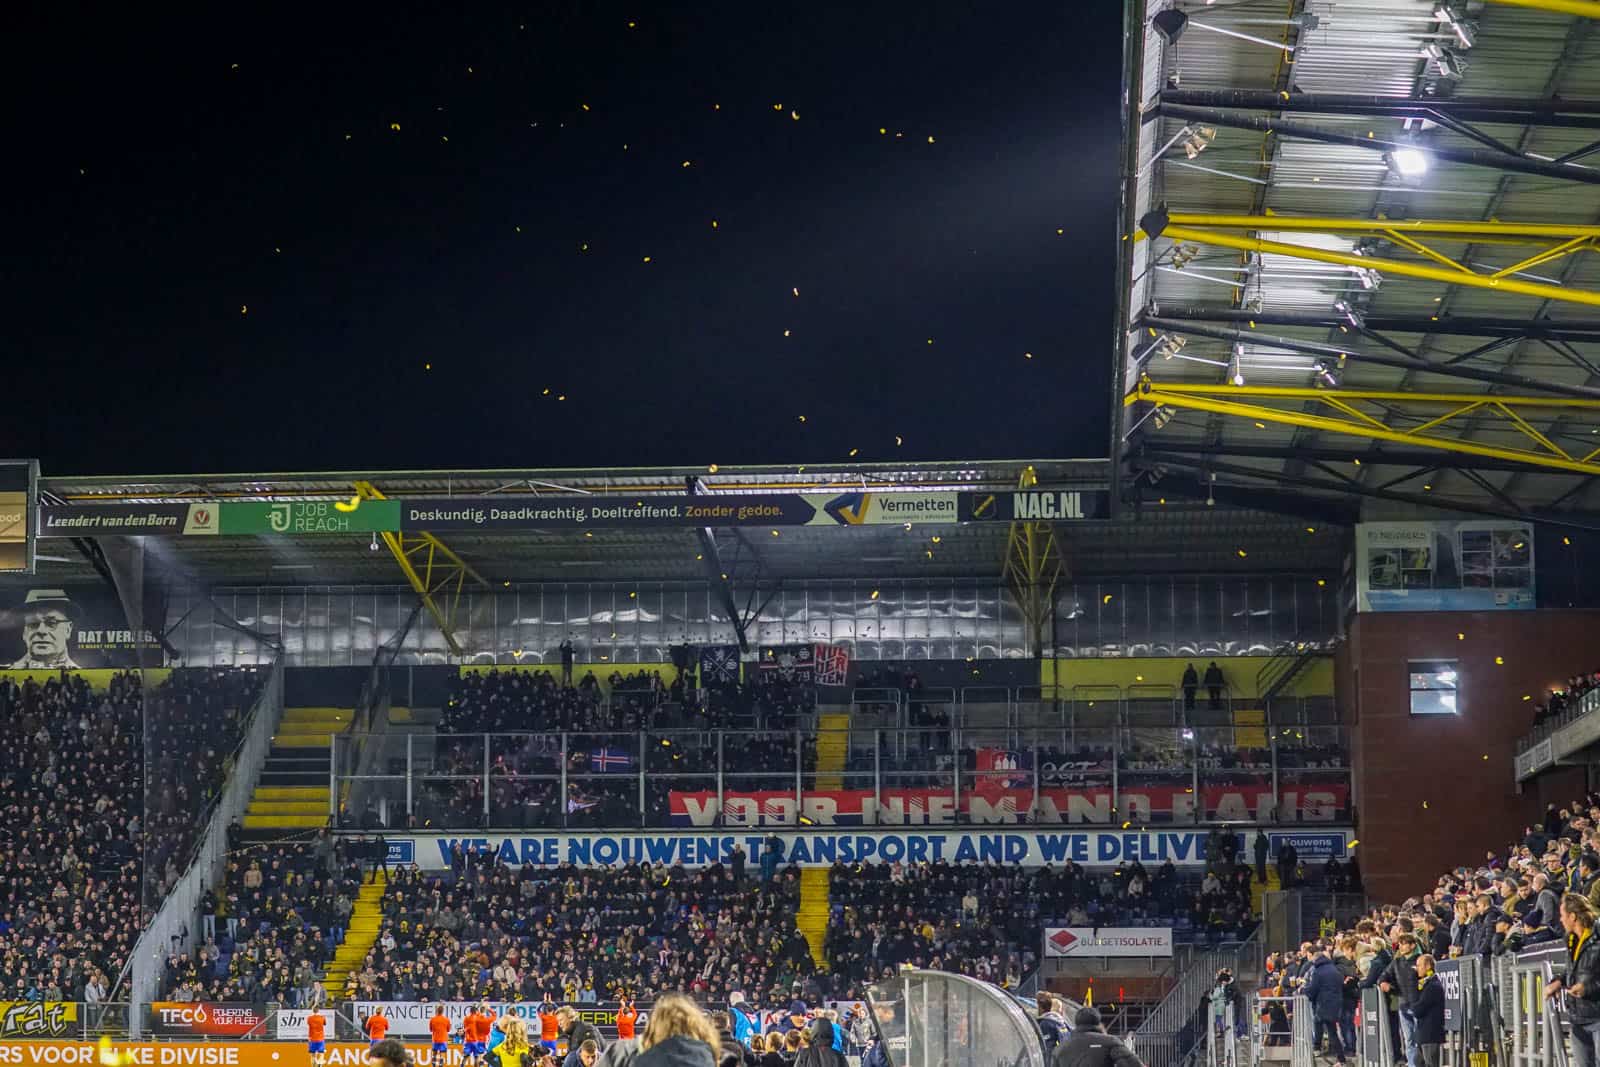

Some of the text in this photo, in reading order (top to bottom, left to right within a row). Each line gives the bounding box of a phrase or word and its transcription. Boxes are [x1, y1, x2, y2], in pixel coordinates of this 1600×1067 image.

[295, 503, 328, 516] JOB
[879, 498, 954, 511] Vermetten
[1013, 493, 1084, 518] NAC.NL
[47, 514, 177, 527] Leendert van den Born
[410, 505, 784, 523] Deskundig. Daadkrachtig. Doeltreffend. Zonder gedoe.
[295, 517, 349, 531] REACH
[78, 631, 103, 643] RAT
[682, 796, 838, 826] VOOR
[862, 793, 1151, 825] NIEMAND
[497, 838, 559, 865] ARE
[568, 837, 736, 865] NOUWENS
[954, 835, 1028, 863] AND
[1036, 834, 1088, 862] WE
[1097, 833, 1246, 862] DELIVE
[235, 1016, 259, 1025] FLEET
[29, 1046, 94, 1064] VOOR
[161, 1047, 239, 1065] DIVISIE
